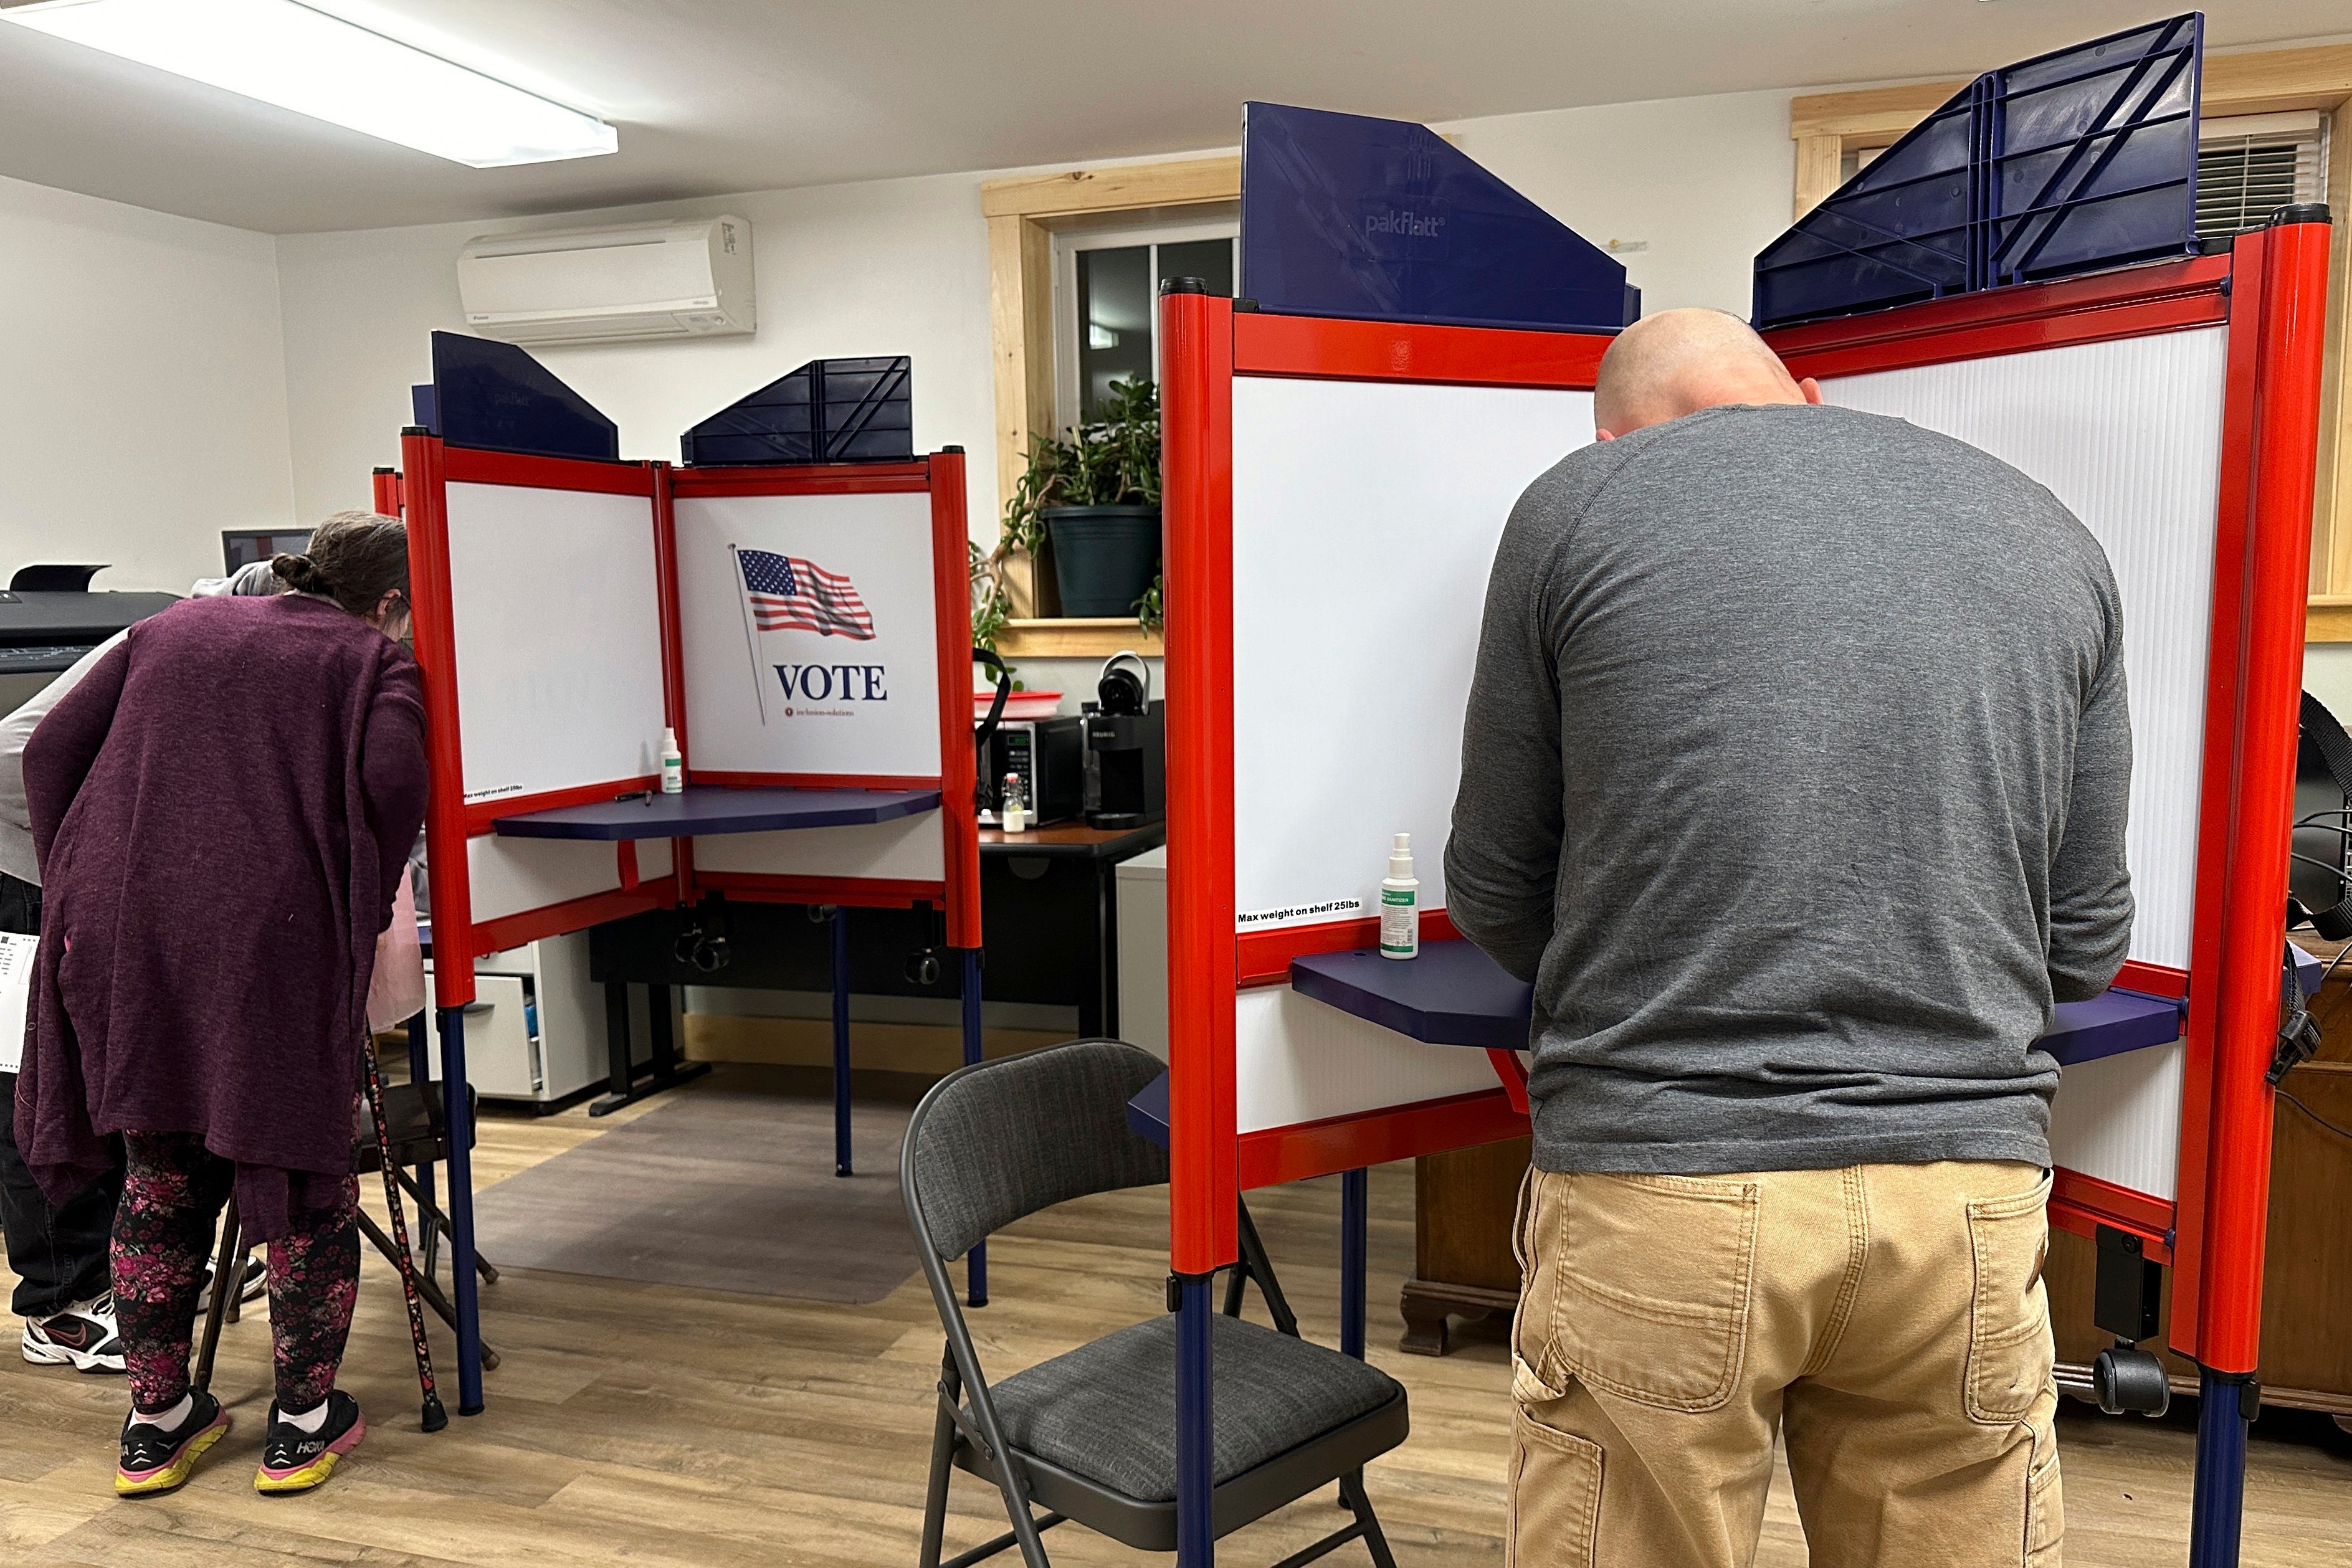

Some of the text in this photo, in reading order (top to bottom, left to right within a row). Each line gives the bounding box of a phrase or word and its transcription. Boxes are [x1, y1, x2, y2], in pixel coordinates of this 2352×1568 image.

[773, 664, 888, 701] VOTE
[1238, 913, 1259, 923] Max
[1260, 908, 1294, 920] weight
[1309, 903, 1333, 914] shelf
[1334, 900, 1359, 911] 25lbs
[296, 1440, 325, 1454] HOKA
